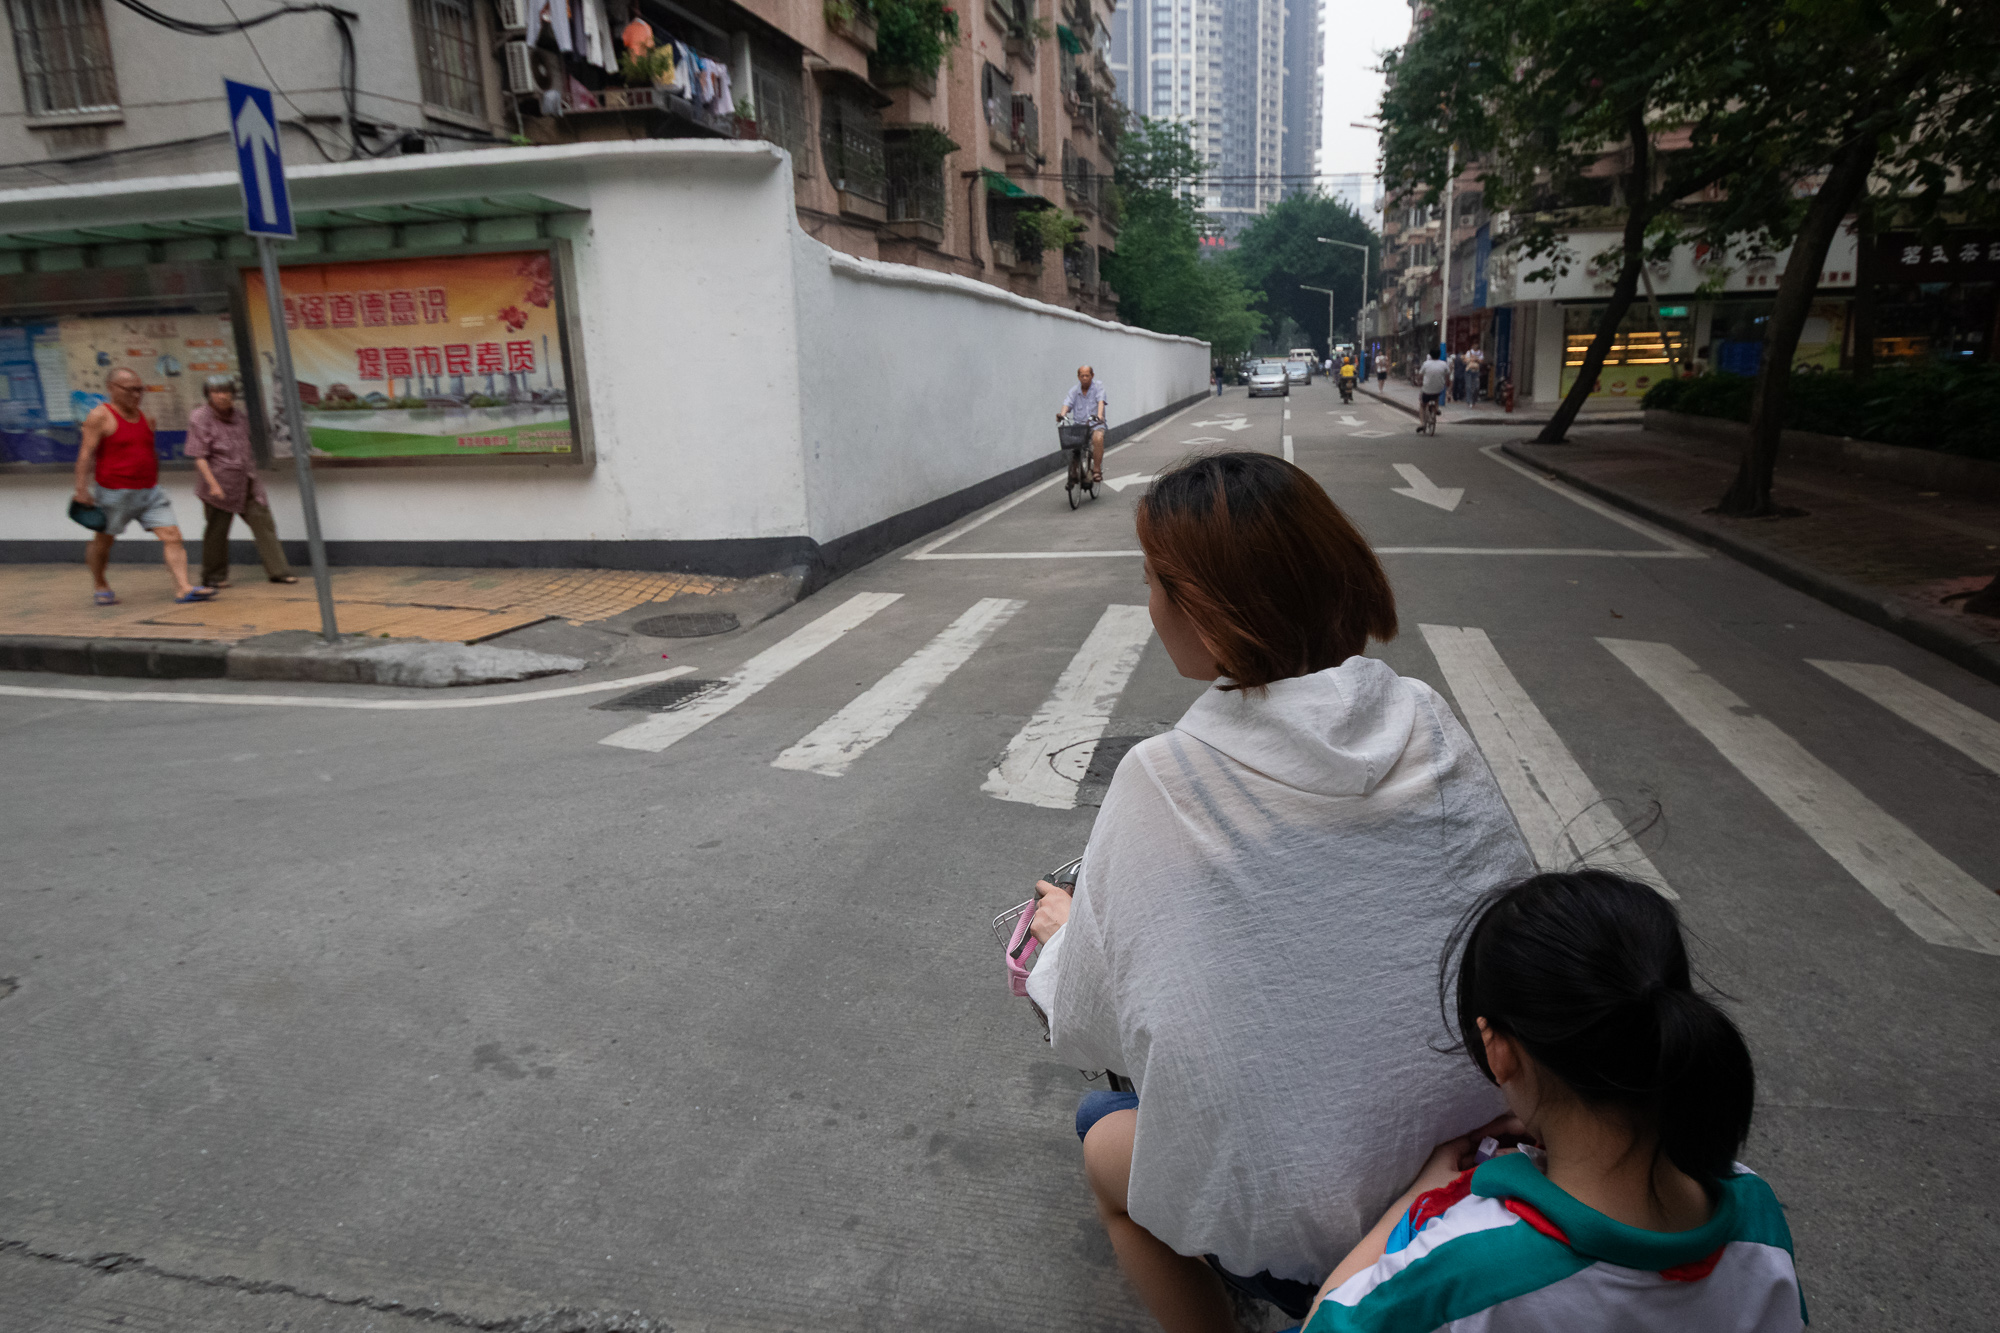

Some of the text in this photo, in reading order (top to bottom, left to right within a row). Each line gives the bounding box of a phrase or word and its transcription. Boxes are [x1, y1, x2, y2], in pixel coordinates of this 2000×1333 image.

[355, 340, 536, 380] 提高市民素质
